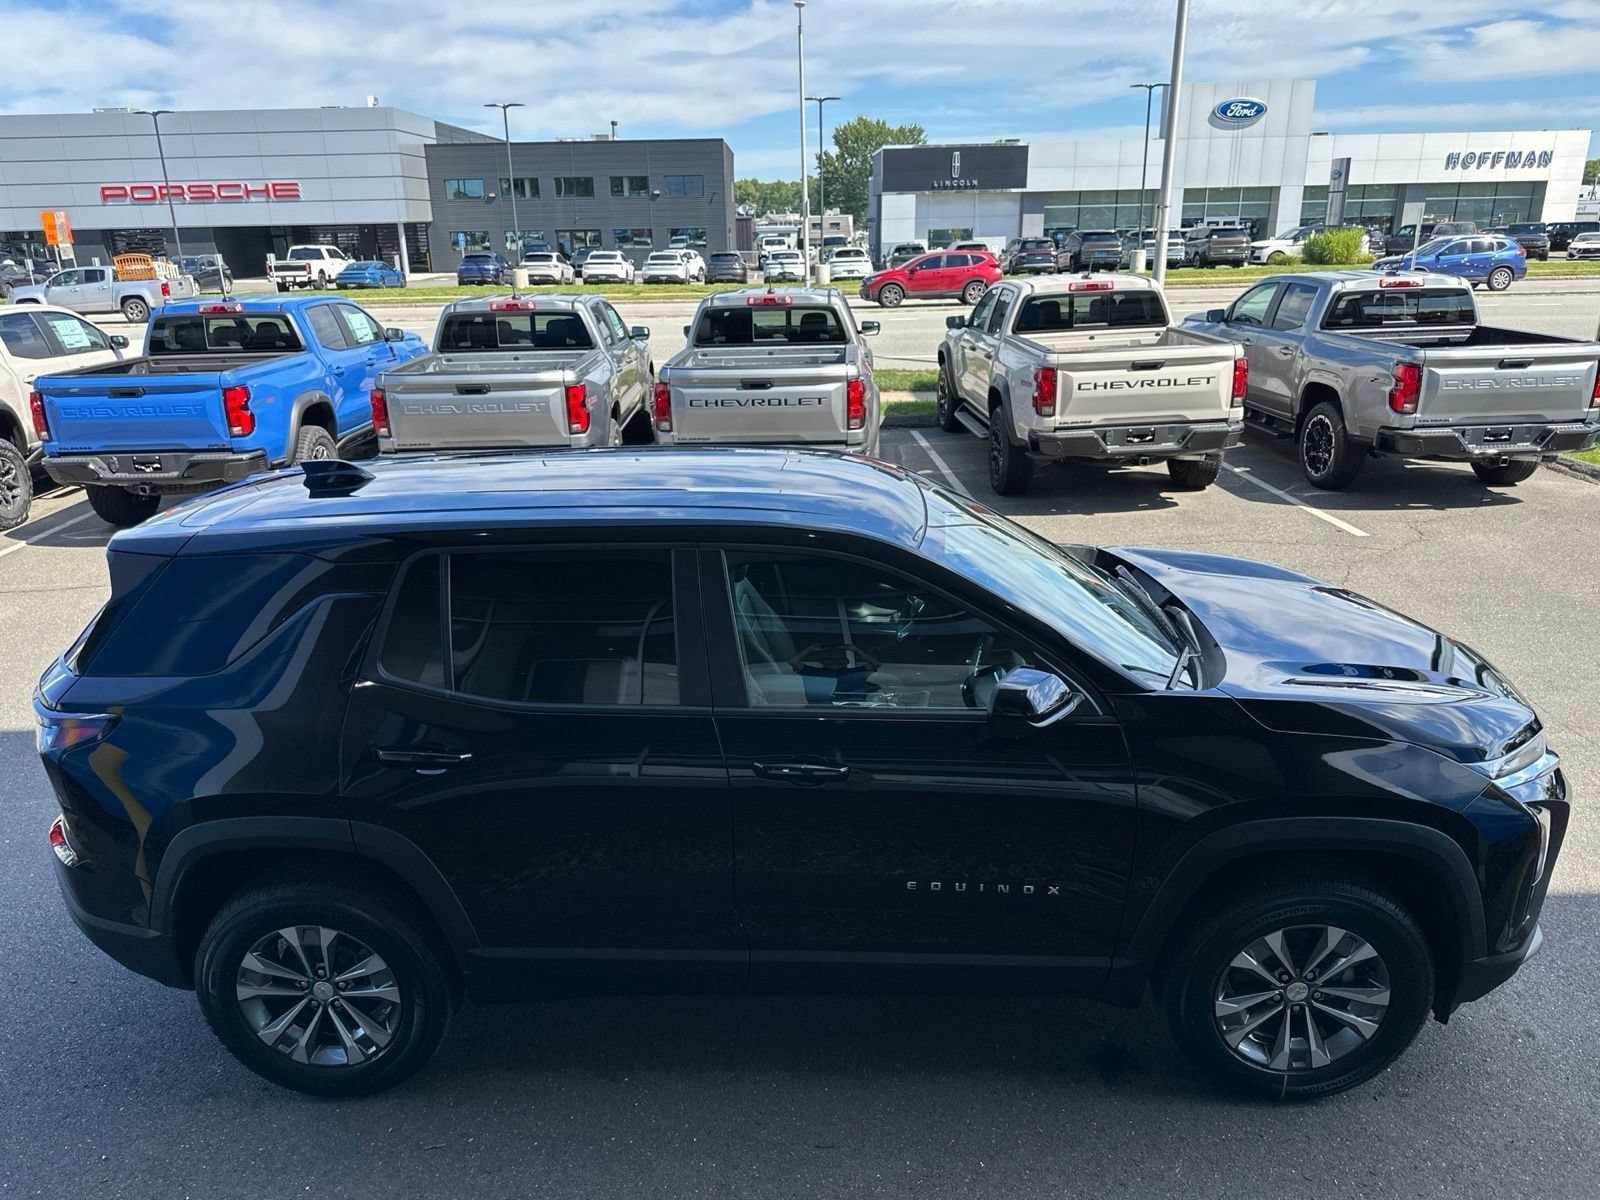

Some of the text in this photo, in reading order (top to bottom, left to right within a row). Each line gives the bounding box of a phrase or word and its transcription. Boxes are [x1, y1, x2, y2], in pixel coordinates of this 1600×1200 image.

[1227, 102, 1258, 117] Ford
[1446, 150, 1553, 168] HOFFMAN
[933, 179, 979, 188] LINCOLN
[101, 182, 301, 202] PORSCHE
[1078, 376, 1216, 391] CHEVROLET
[1442, 375, 1582, 391] CHEVROLET
[404, 401, 548, 415] CHEVROLET
[689, 396, 828, 409] CHEVROLET
[61, 404, 203, 418] CHEVROLET
[906, 881, 1060, 895] EQUINOX
